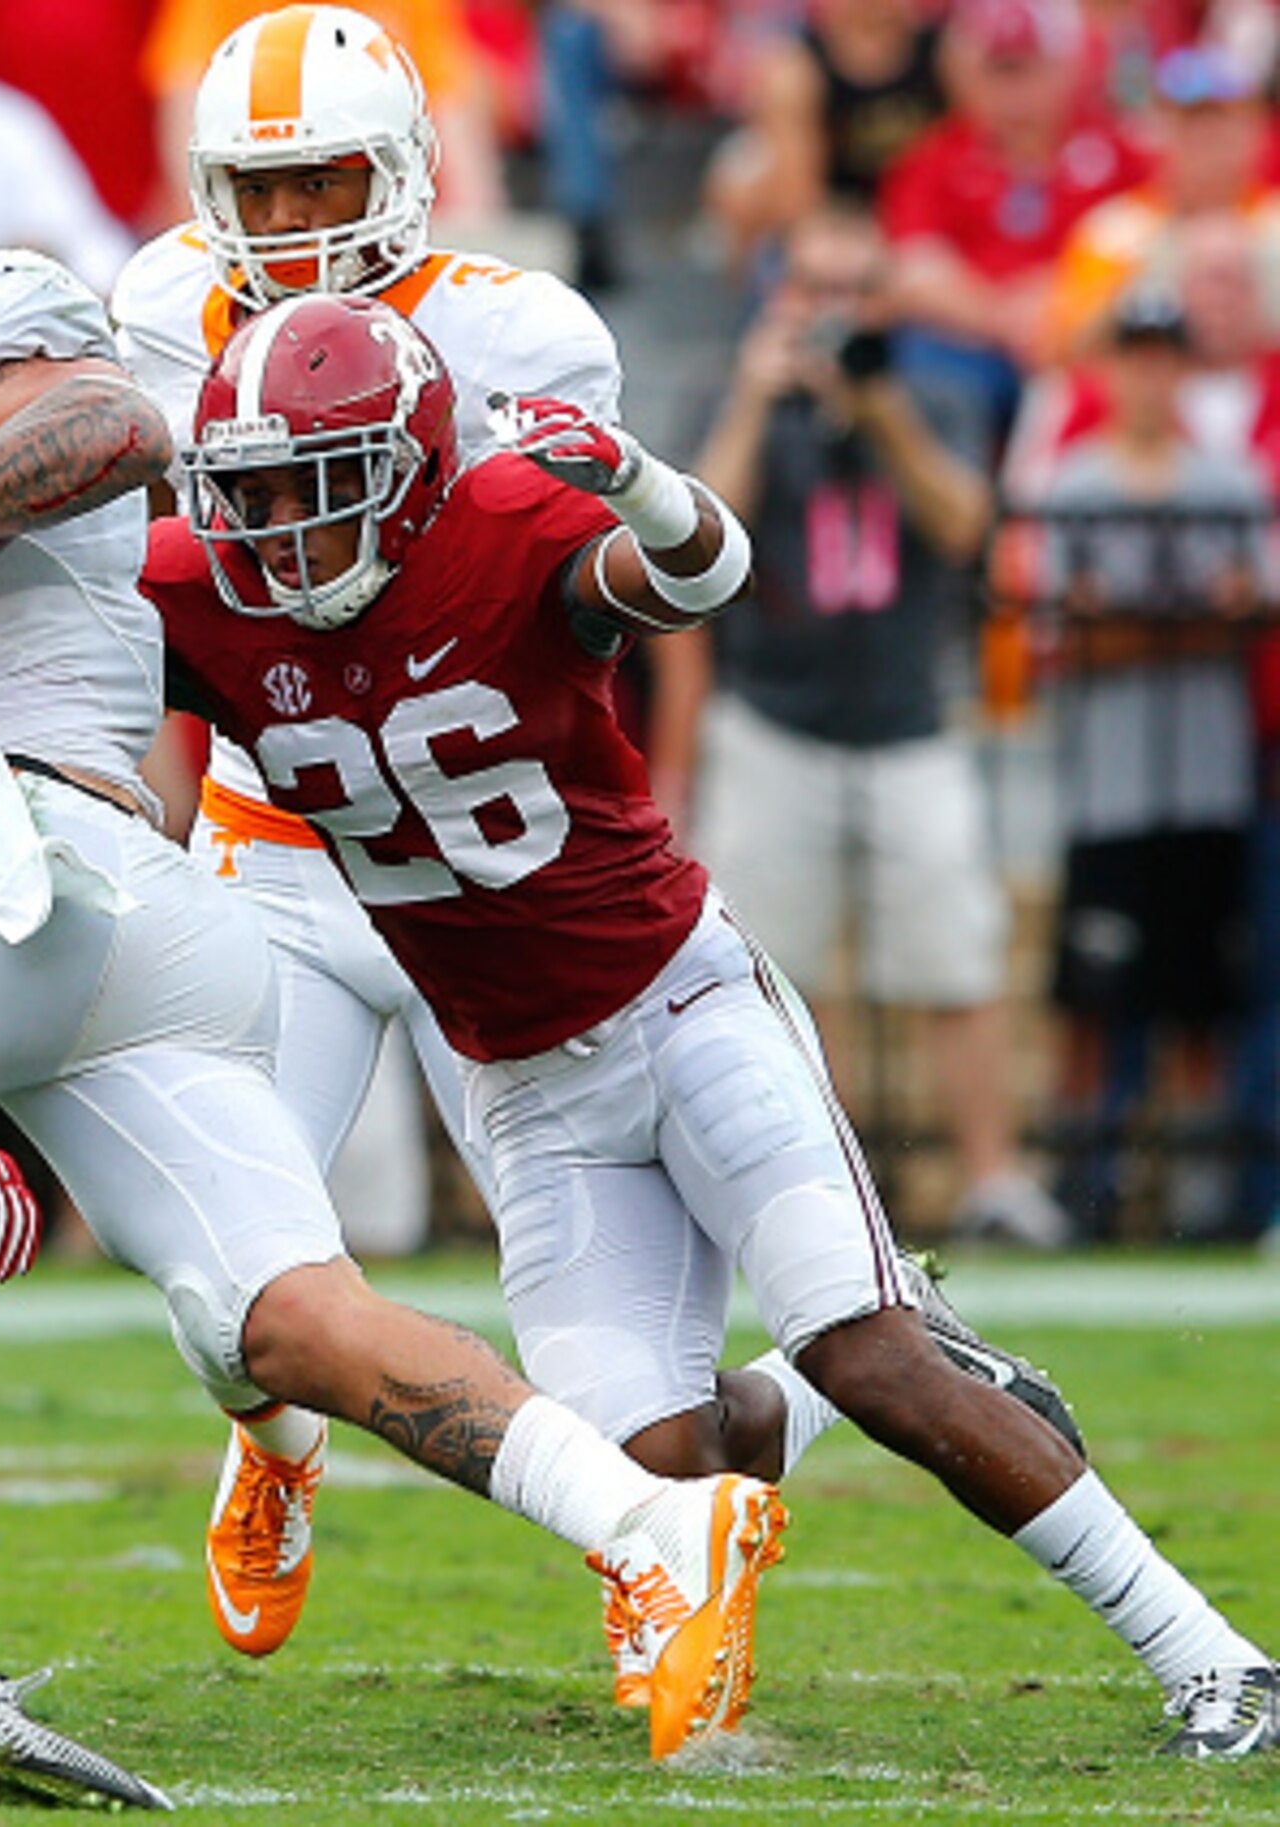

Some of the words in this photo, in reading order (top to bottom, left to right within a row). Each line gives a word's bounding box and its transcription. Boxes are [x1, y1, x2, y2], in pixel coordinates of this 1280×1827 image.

[261, 661, 313, 716] SEC
[255, 681, 570, 905] 26
[211, 828, 252, 877] T
